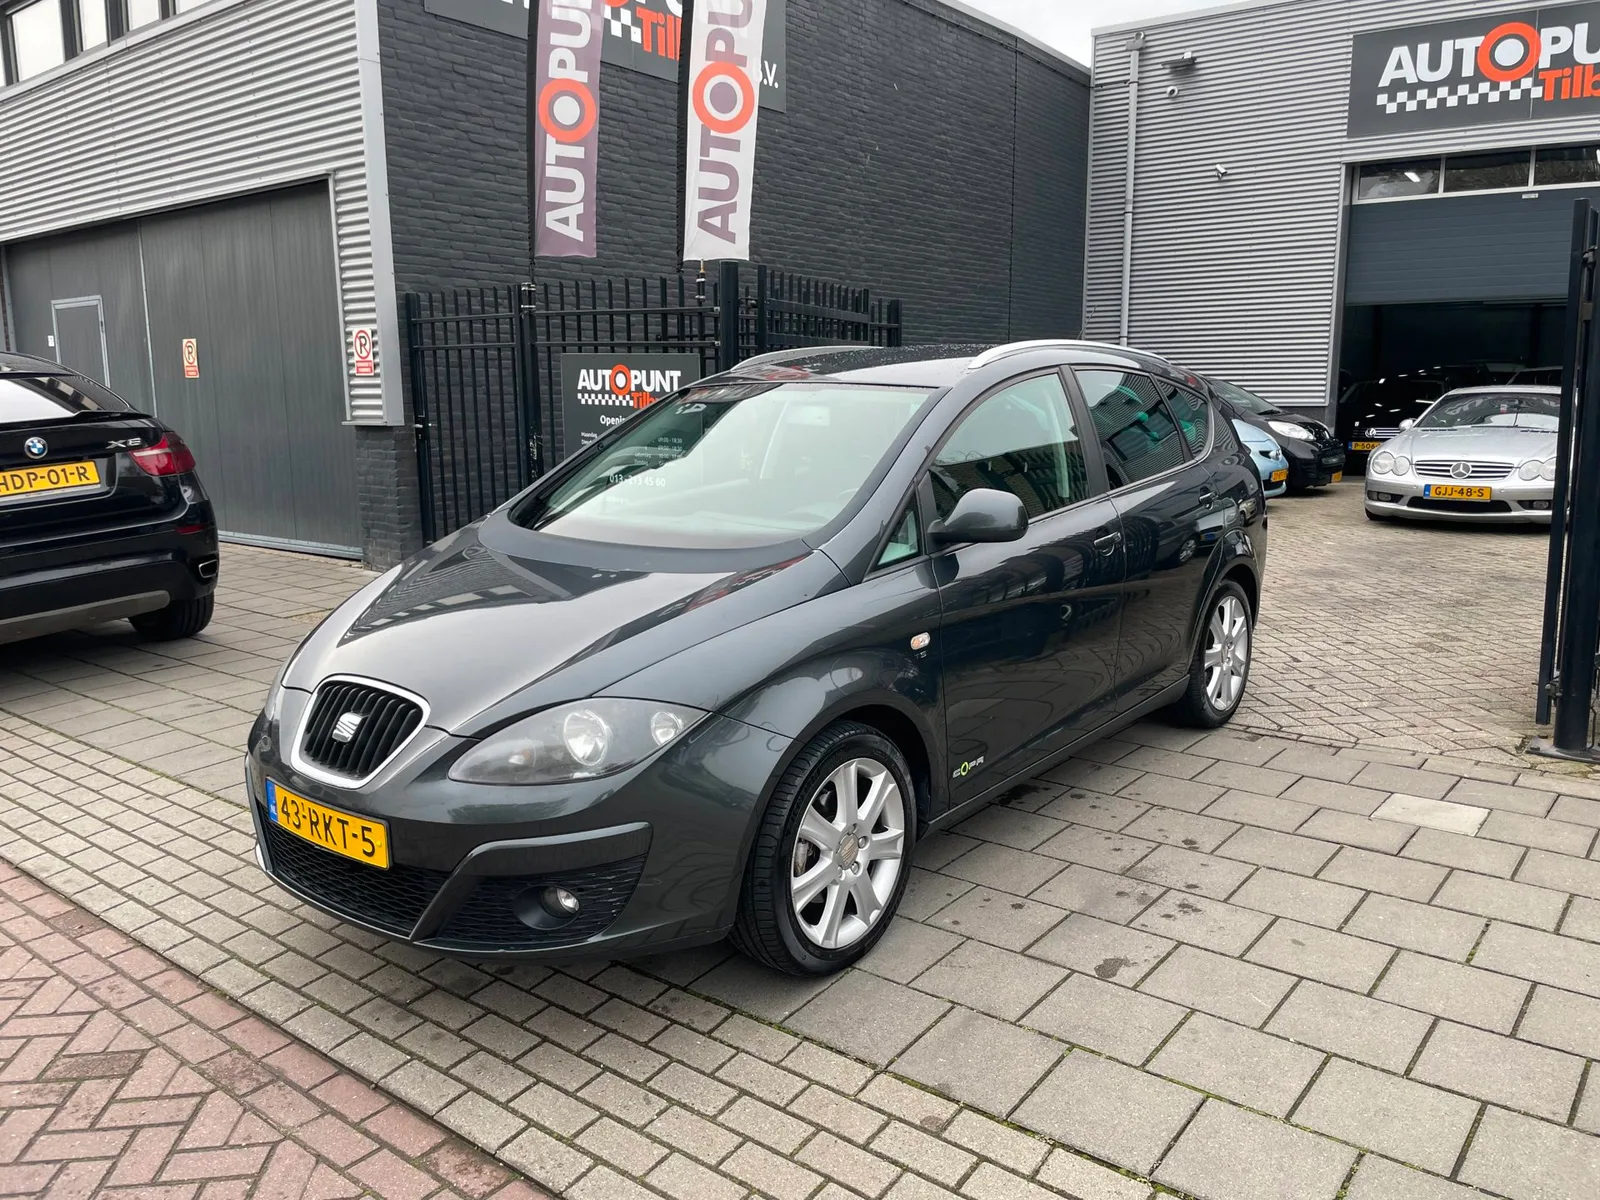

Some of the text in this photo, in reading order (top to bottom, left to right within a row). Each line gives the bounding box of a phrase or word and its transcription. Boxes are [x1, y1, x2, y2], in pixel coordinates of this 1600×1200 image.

[537, 0, 597, 243] AUTOPU
[578, 364, 681, 396] AUTOPUNT
[631, 391, 659, 409] Tilb
[105, 437, 142, 450] X6
[1353, 442, 1381, 450] P-506-
[1434, 486, 1485, 498] GJJ-48-S
